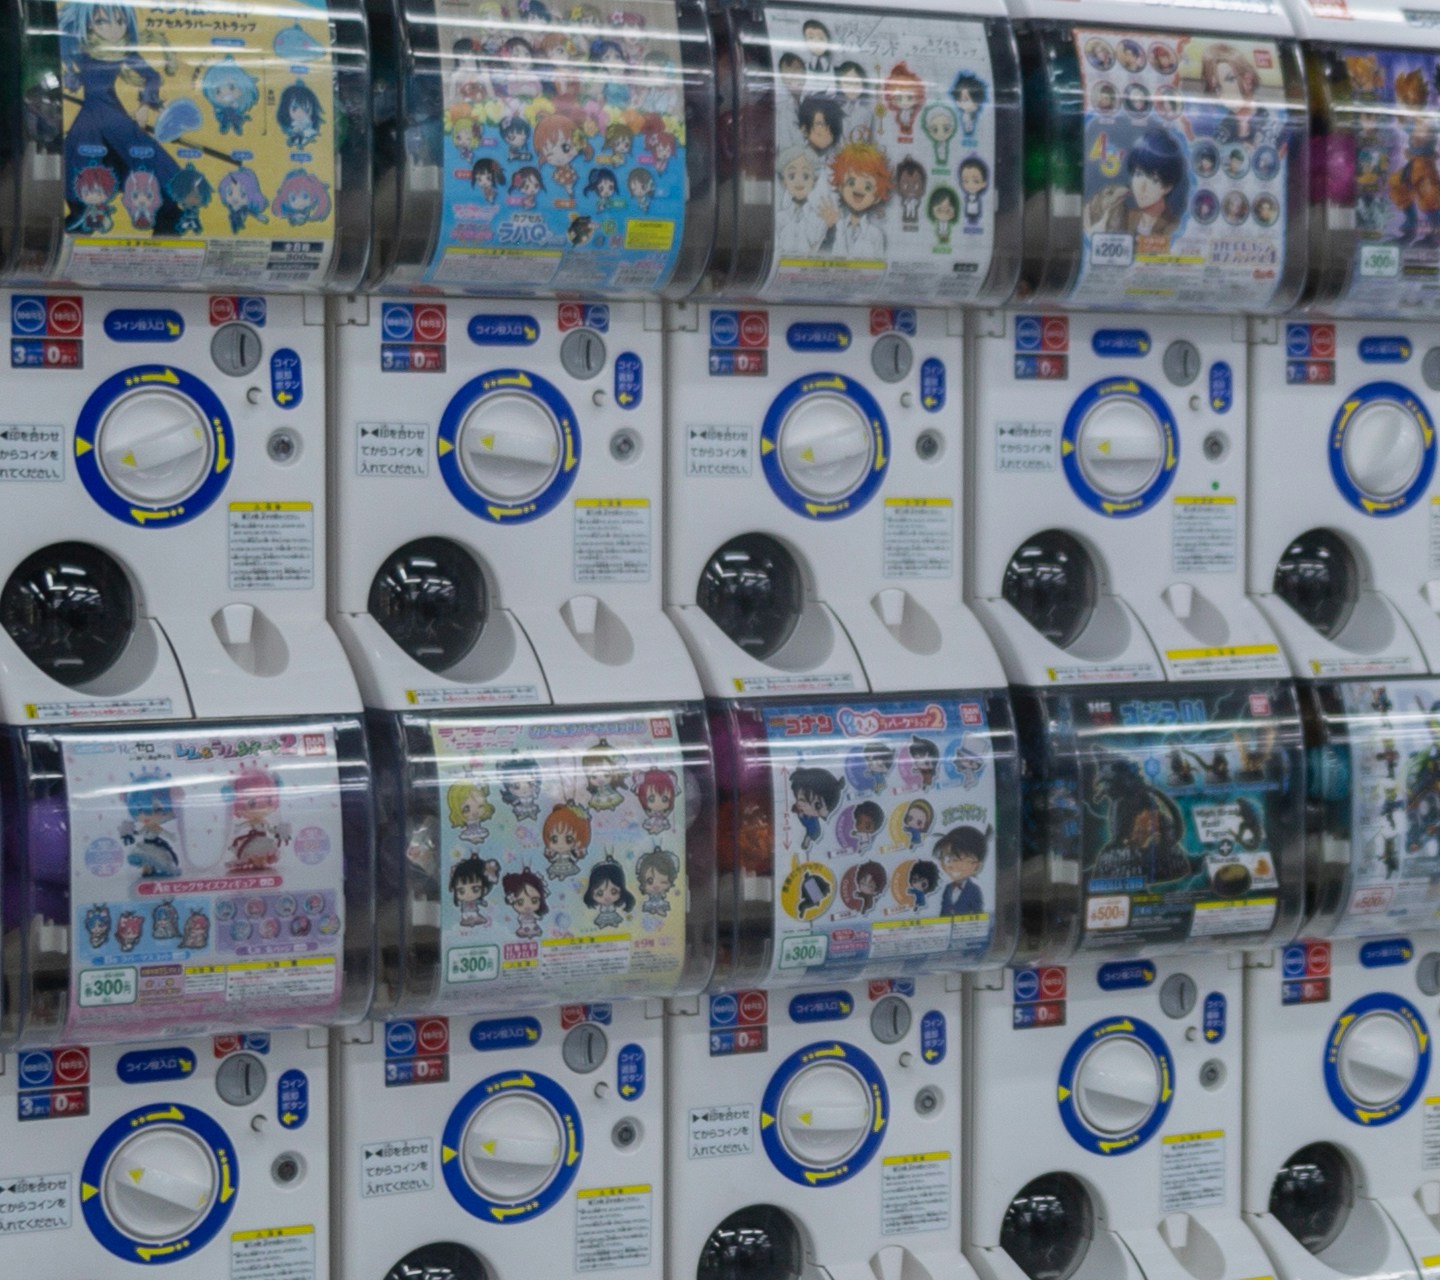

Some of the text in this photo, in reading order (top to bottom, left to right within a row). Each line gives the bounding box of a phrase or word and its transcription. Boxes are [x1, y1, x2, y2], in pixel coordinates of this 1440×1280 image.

[273, 357, 298, 368] コイン
[361, 446, 424, 457] てからコインを
[281, 1077, 306, 1088] コイン
[366, 1162, 428, 1176] てからコインを
